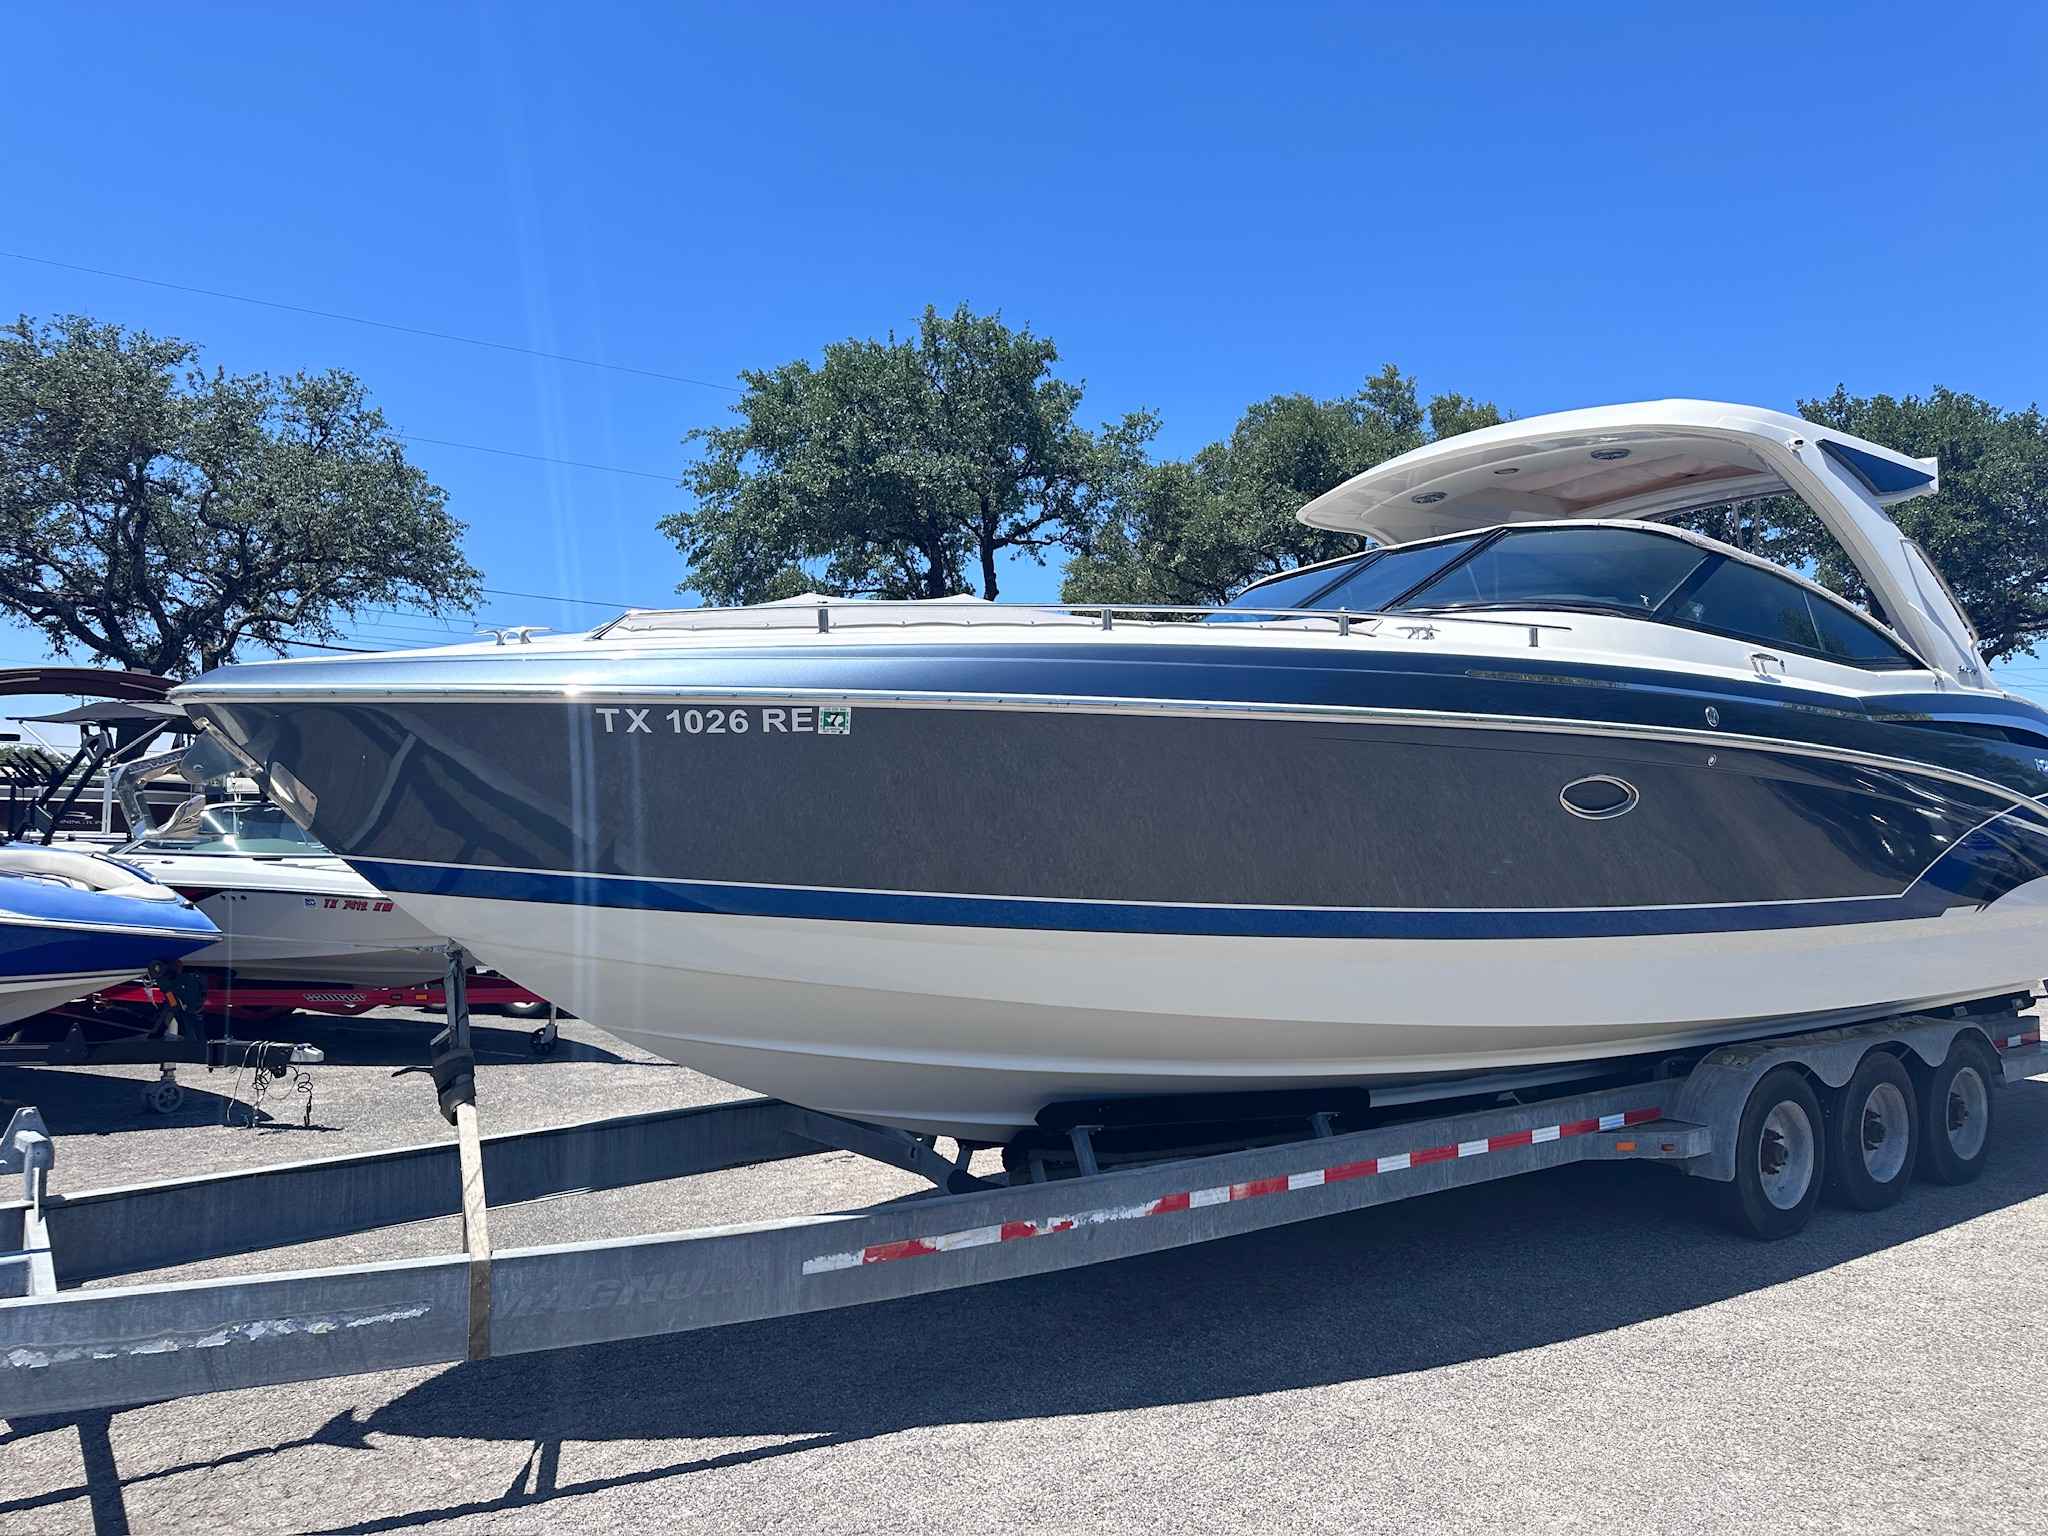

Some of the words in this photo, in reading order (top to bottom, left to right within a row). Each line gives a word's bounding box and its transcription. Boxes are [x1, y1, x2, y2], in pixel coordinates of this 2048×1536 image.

[596, 708, 652, 733] TX
[666, 709, 749, 734] 1026
[762, 708, 814, 733] RE
